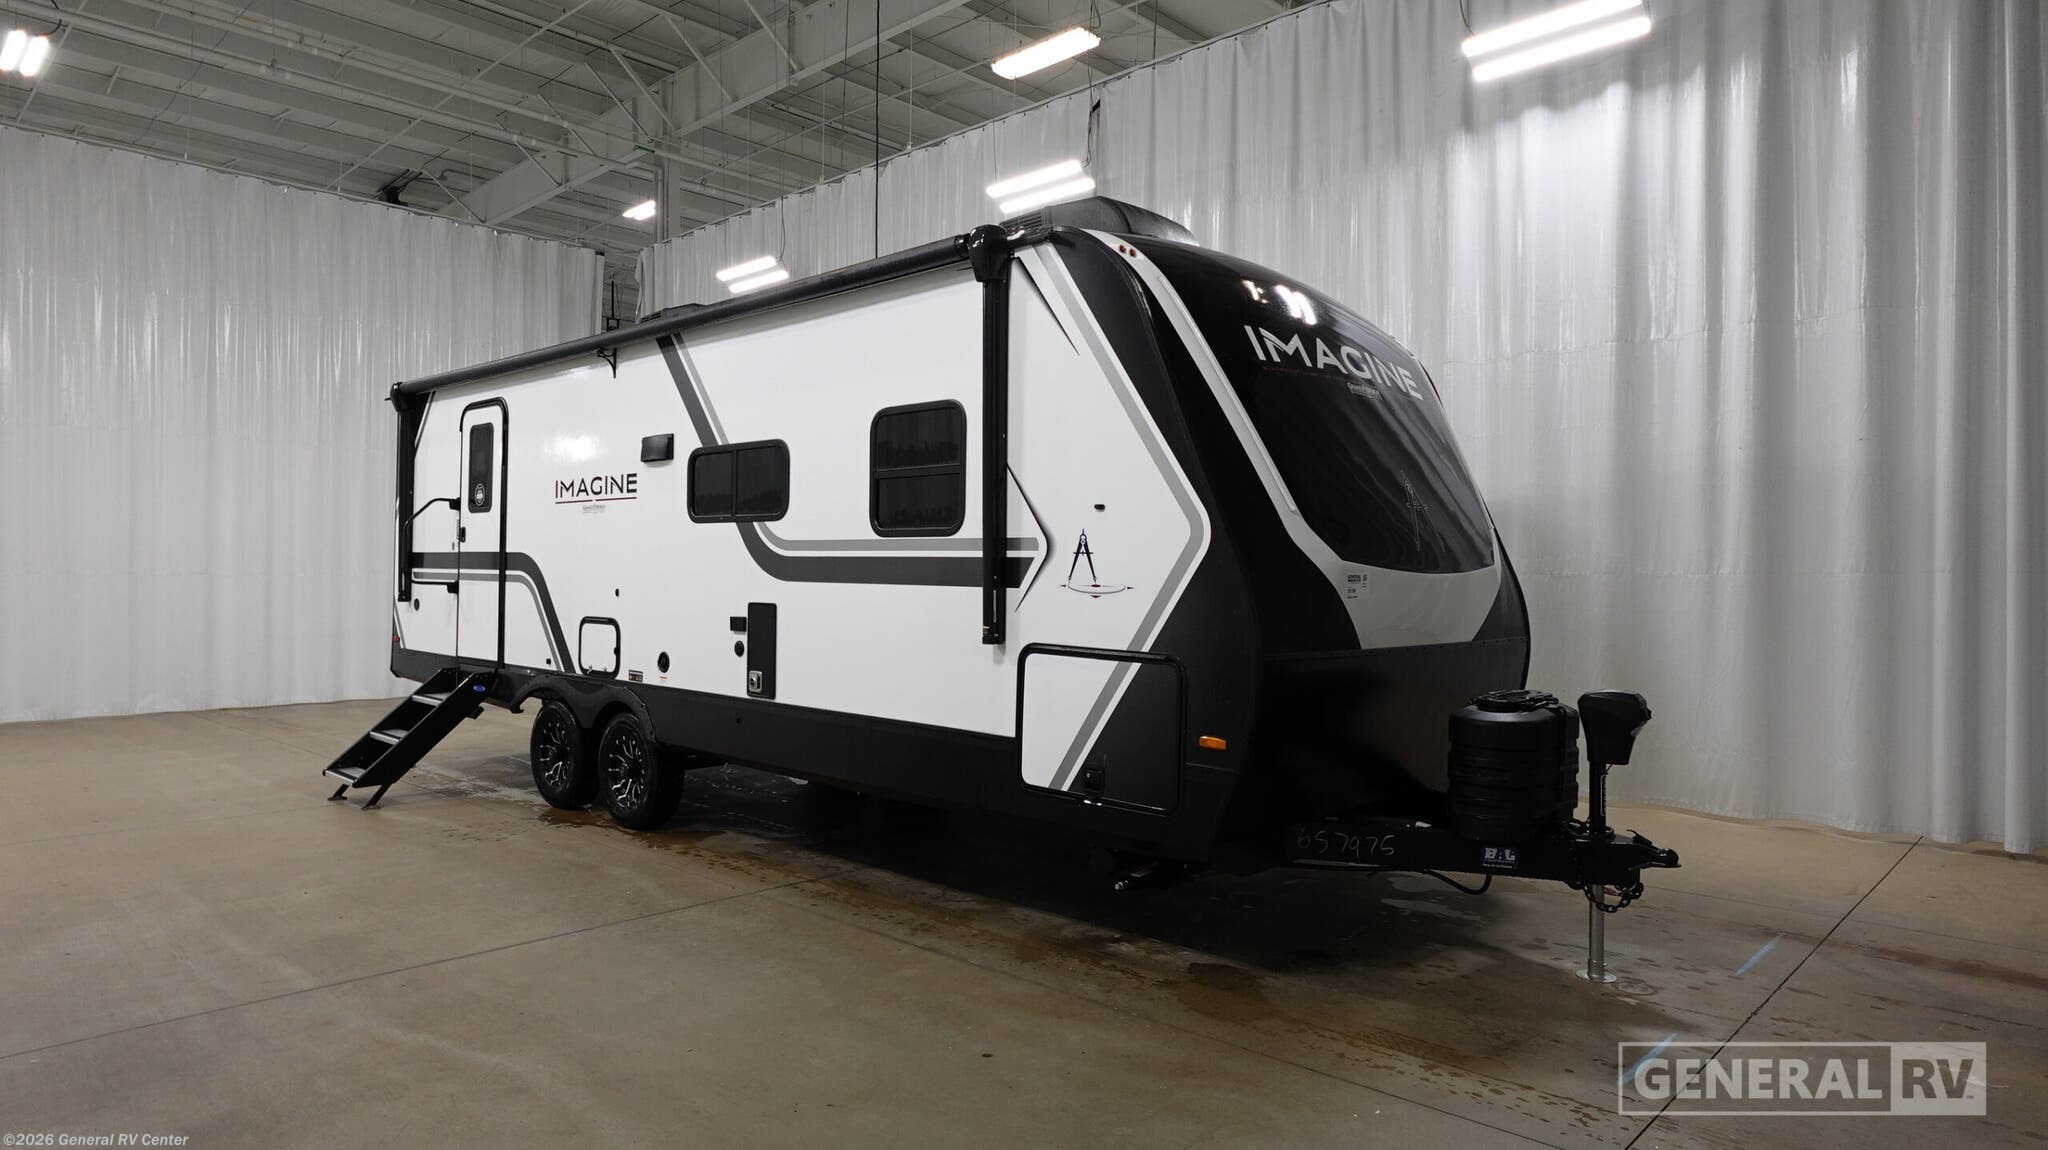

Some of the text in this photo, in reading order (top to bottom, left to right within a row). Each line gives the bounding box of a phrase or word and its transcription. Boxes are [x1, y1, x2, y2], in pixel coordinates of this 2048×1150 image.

[1244, 325, 1424, 401] IMAGINE
[555, 473, 638, 499] IMAGINE
[1296, 827, 1397, 858] 657975
